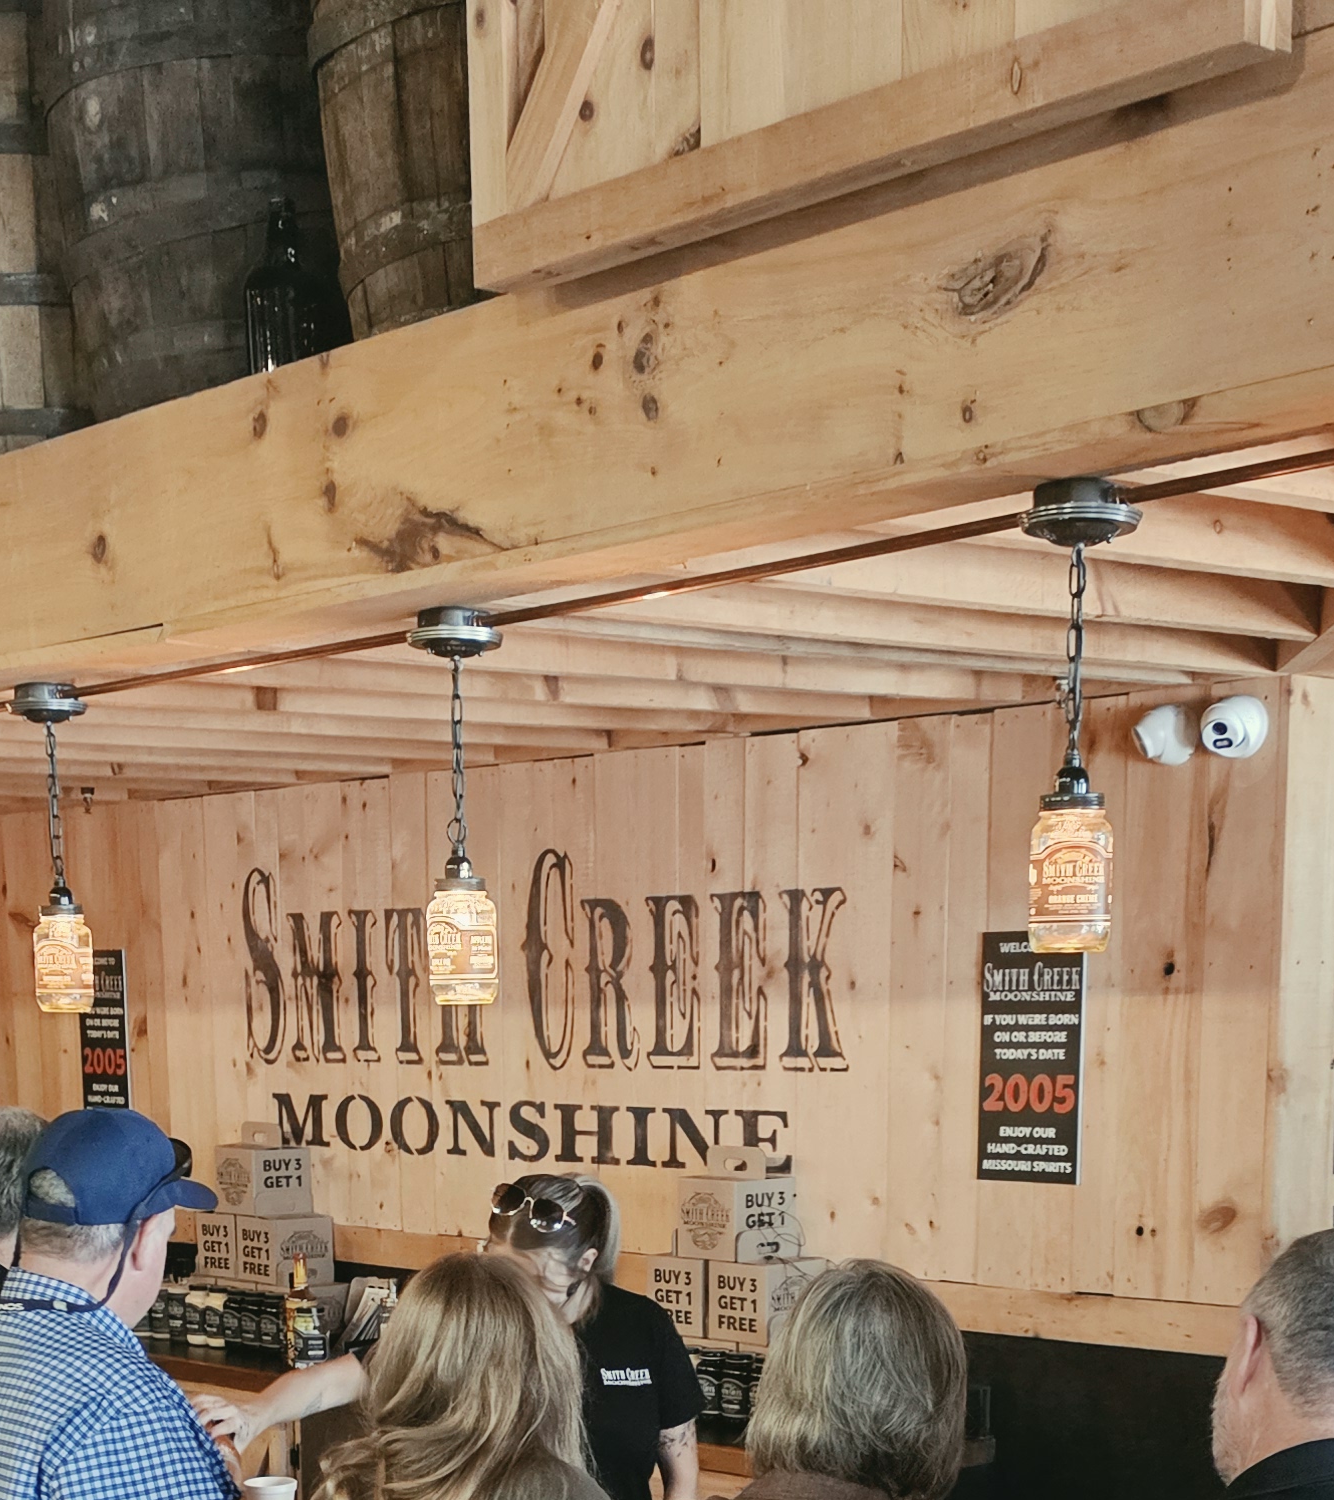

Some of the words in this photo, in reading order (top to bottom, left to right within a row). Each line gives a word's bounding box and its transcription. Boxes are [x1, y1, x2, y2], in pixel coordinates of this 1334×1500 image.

[521, 847, 850, 1073] CREEK
[984, 962, 1029, 992] SMITH
[1033, 961, 1081, 991] CREEK
[988, 991, 1076, 1002] MOONSHINE
[984, 1014, 994, 1025] IF
[995, 1014, 1016, 1025] YOU
[1017, 1014, 1048, 1026] WERE
[1048, 1014, 1080, 1026] BORN
[993, 1031, 1010, 1042] ON
[1011, 1031, 1027, 1042] OR
[1028, 1031, 1068, 1043] BEFORE
[83, 1047, 126, 1076] 2005
[994, 1049, 1038, 1060] TODAY'S
[1038, 1049, 1066, 1060] DATE
[983, 1073, 1076, 1115] 2005
[273, 1092, 794, 1174] MOONSHINE
[999, 1126, 1032, 1138] ENJOY
[1032, 1127, 1056, 1139] OUR
[987, 1143, 1069, 1156] HAND-CRAFTED
[263, 1159, 292, 1172] BUY
[294, 1158, 302, 1170] 3
[982, 1159, 1032, 1172] MISSOURI
[1033, 1161, 1073, 1174] SPIRITS
[263, 1176, 293, 1189] GET
[296, 1175, 303, 1187] 1
[745, 1192, 774, 1208] BUY
[778, 1191, 786, 1206] 3
[745, 1212, 774, 1228] GET
[778, 1211, 785, 1226] 1
[201, 1224, 221, 1237] BUY
[222, 1226, 229, 1237] 3
[242, 1229, 263, 1243] BUY
[264, 1231, 270, 1244] 3
[203, 1240, 224, 1253] GET
[224, 1242, 229, 1254] 1
[243, 1245, 264, 1259] GET
[265, 1248, 270, 1260] 1
[204, 1256, 230, 1270] FREE
[243, 1262, 270, 1276] FREE
[654, 1268, 682, 1284] BUY
[685, 1271, 692, 1286] 3
[717, 1275, 747, 1292] BUY
[750, 1278, 757, 1293] 3
[654, 1288, 683, 1304] GET
[686, 1292, 692, 1305] 1
[718, 1295, 748, 1312] GET
[751, 1299, 757, 1313] 1
[667, 1310, 693, 1325] REE
[718, 1314, 758, 1333] FREE
